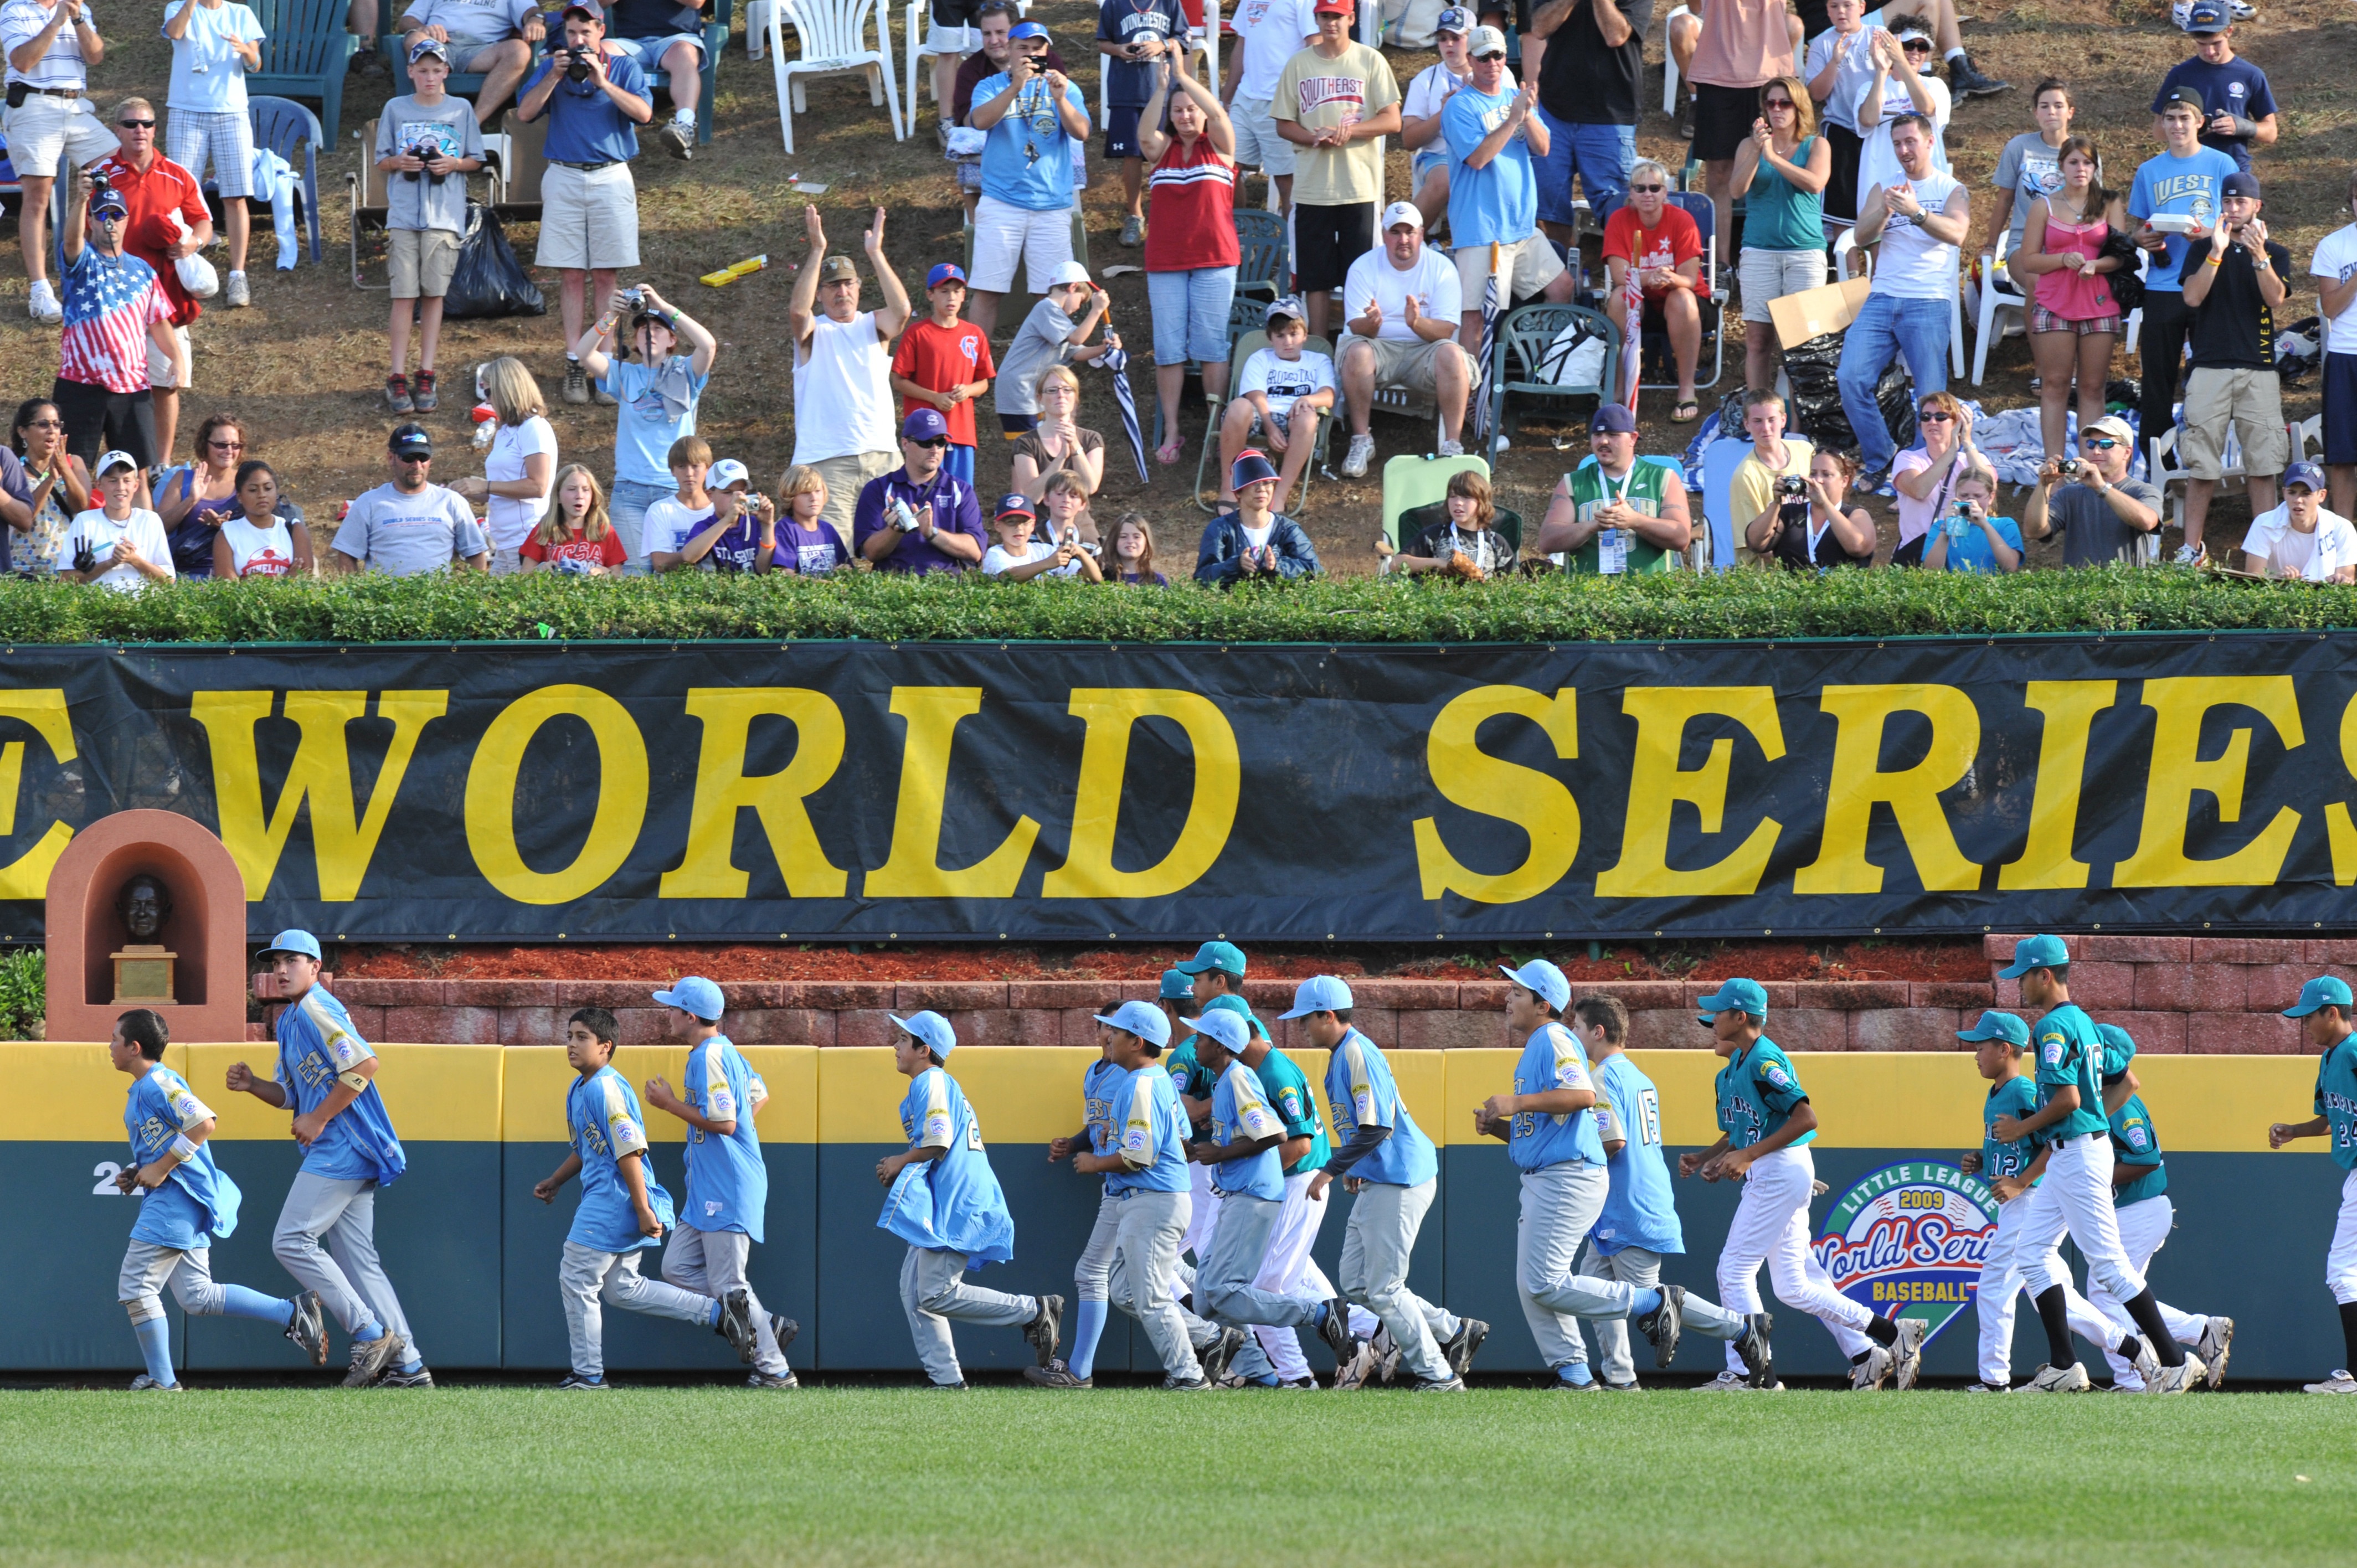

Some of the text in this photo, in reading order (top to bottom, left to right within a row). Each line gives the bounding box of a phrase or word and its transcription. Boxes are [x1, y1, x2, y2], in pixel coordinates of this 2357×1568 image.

[1299, 76, 1365, 115] SOUTHEAST
[1482, 104, 1513, 132] WES
[2153, 174, 2214, 207] WEST
[190, 683, 1241, 905] WORLD
[1413, 675, 2357, 904] SERIE
[1086, 1098, 1113, 1120] EST
[1636, 1089, 1660, 1146] 15
[138, 1115, 161, 1146] ES
[580, 1121, 600, 1151] ES
[1993, 1153, 2020, 1179] 12
[1841, 1165, 1999, 1214] LITTLE LEAGUE
[1900, 1191, 1944, 1209] 2009
[1913, 1222, 1994, 1263] Seri
[1873, 1282, 1970, 1302] BASEBALL
